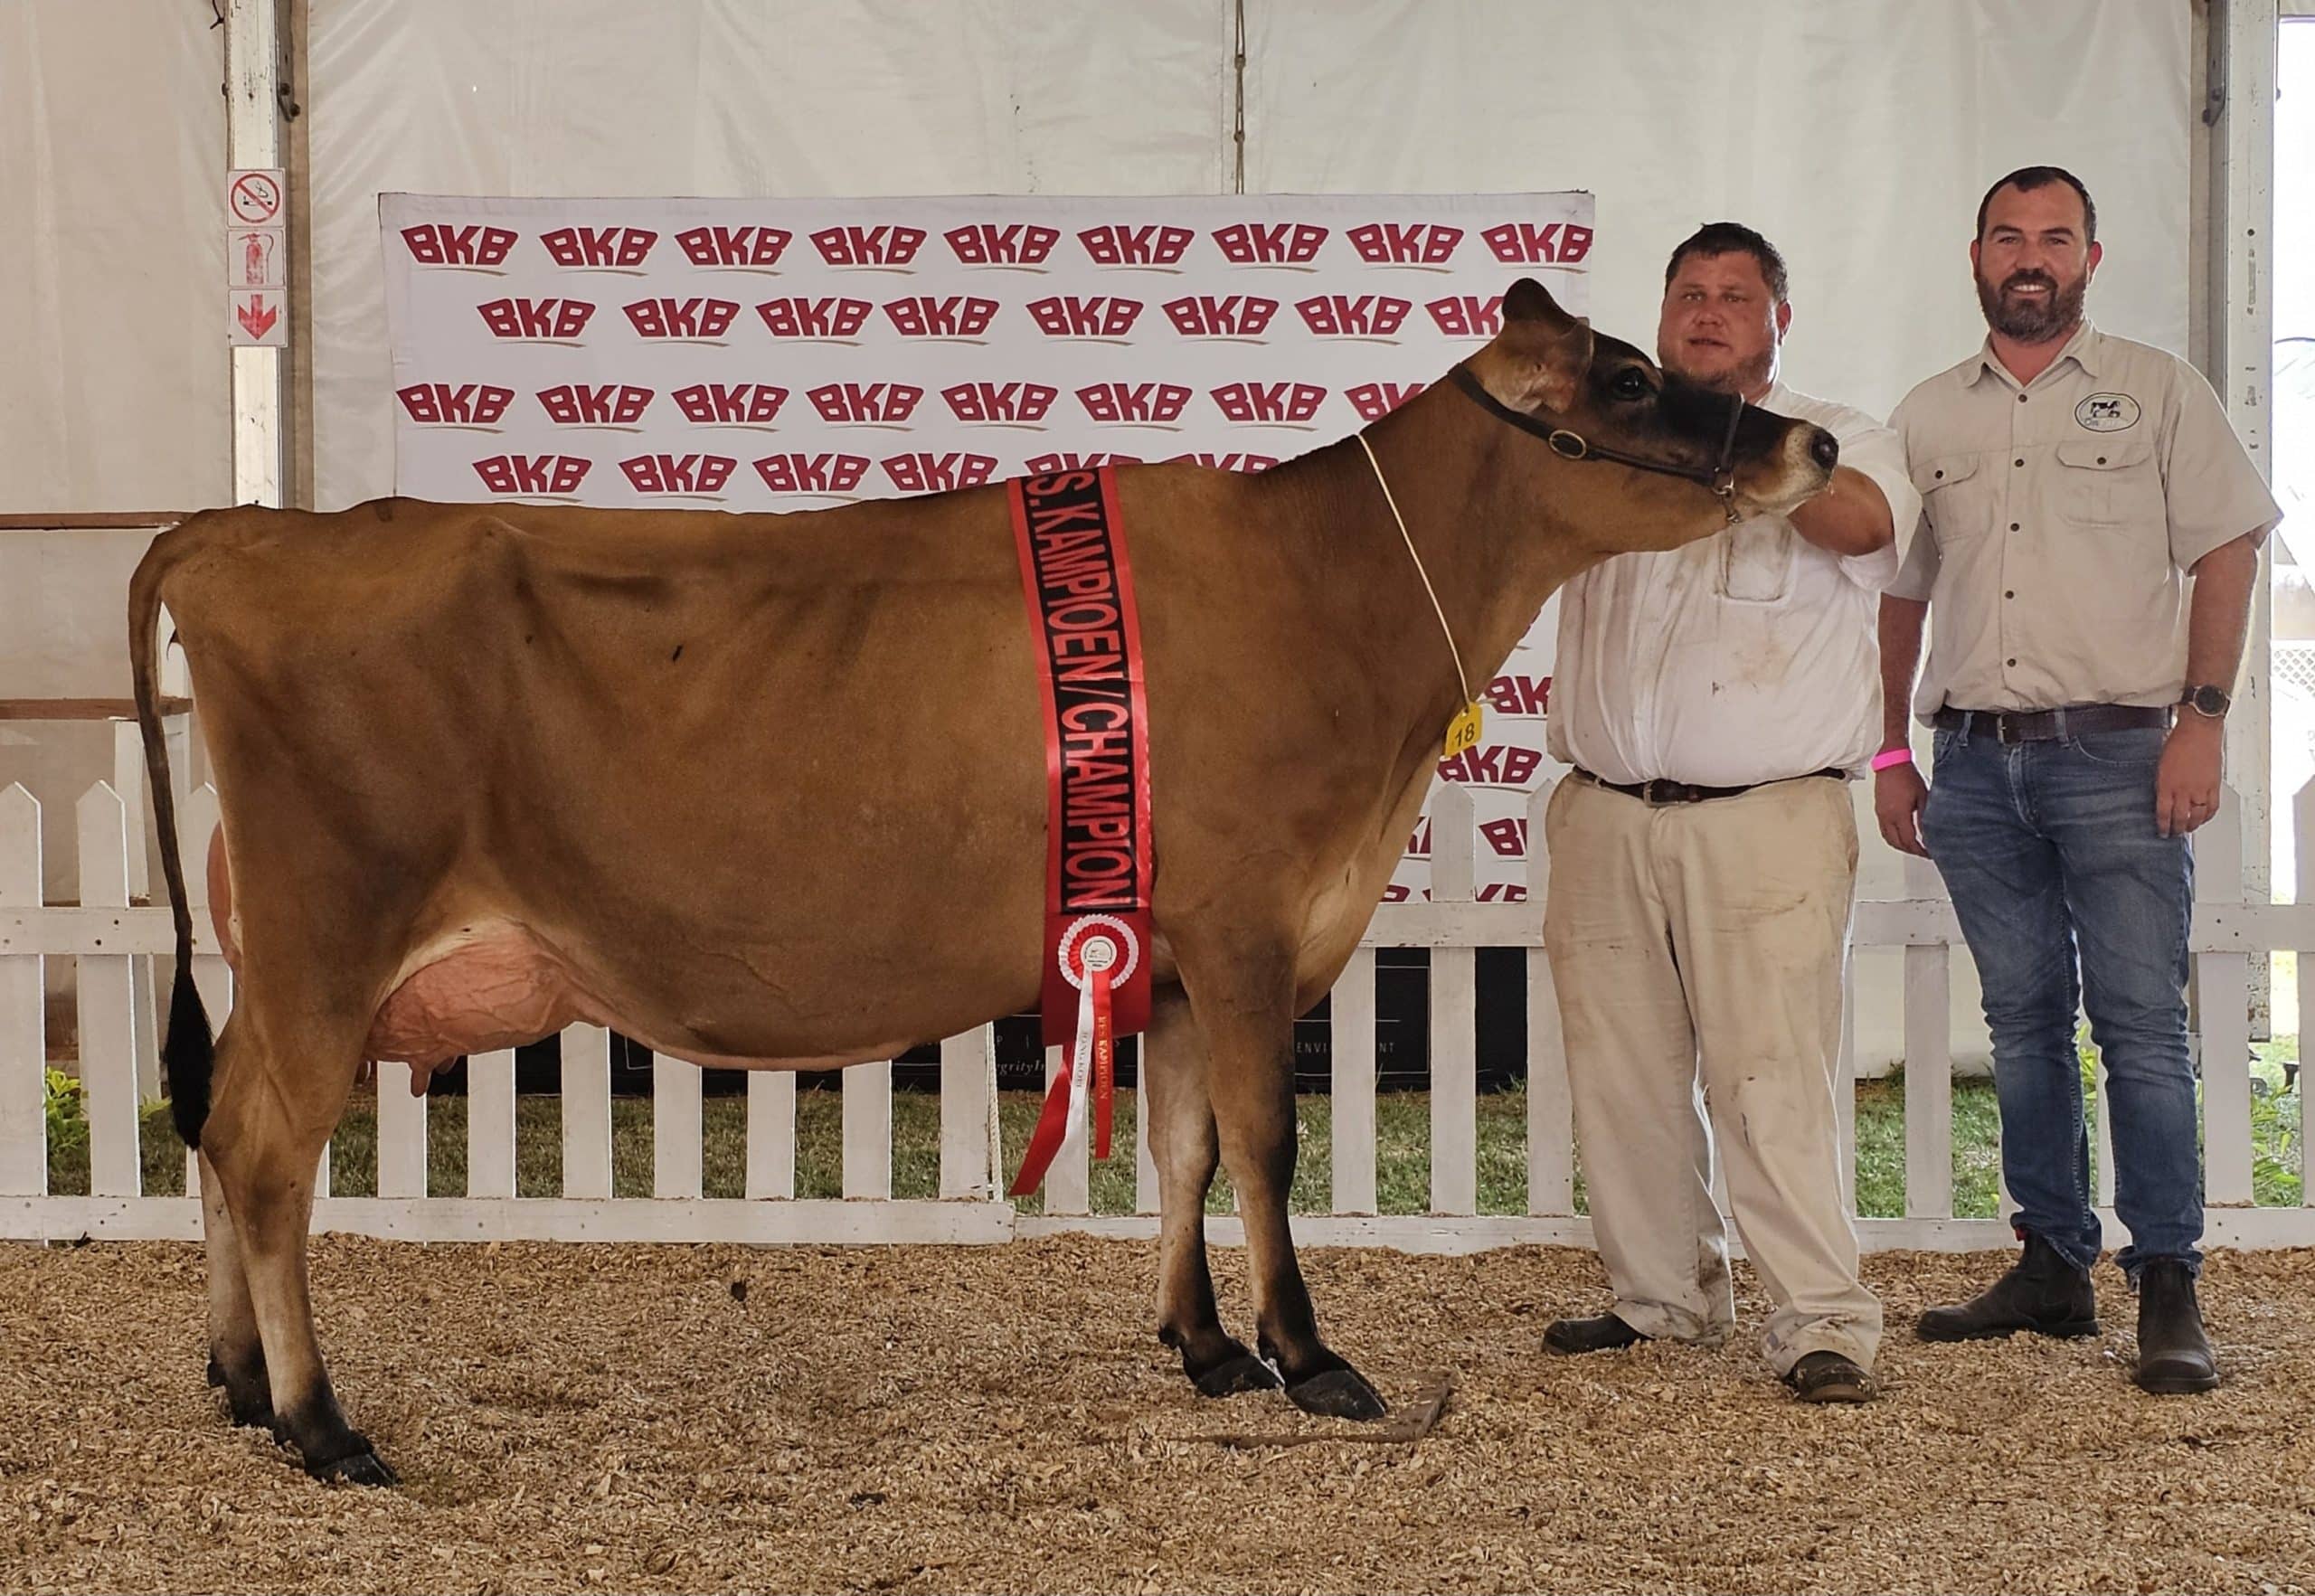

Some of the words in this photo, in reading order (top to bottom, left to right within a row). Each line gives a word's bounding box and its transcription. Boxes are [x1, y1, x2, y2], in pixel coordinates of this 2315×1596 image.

[402, 224, 518, 265] BKB
[541, 227, 657, 266] BKB
[676, 227, 792, 265] BKB
[810, 226, 927, 265] BKB
[945, 224, 1060, 264] BKB
[1079, 225, 1194, 264] BKB
[1214, 224, 1328, 262] BKB
[1346, 223, 1463, 263] BKB
[1482, 223, 1593, 263] BKB
[478, 297, 595, 338] BKB
[624, 297, 741, 337] BKB
[756, 297, 873, 337] BKB
[883, 296, 999, 336] BKB
[1026, 296, 1144, 335] BKB
[1164, 296, 1279, 335] BKB
[1296, 296, 1412, 335] BKB
[1426, 296, 1504, 337] BK
[398, 383, 514, 424] BKB
[537, 384, 654, 423] BKB
[672, 383, 789, 423] BKB
[808, 382, 924, 422] BKB
[942, 382, 1057, 421] BKB
[1077, 382, 1192, 421] BKB
[1211, 382, 1327, 421] BKB
[1345, 382, 1425, 421] BK
[473, 455, 591, 493] BKB
[620, 454, 737, 493] BKB
[753, 453, 870, 492] BKB
[882, 453, 998, 492] BKB
[1485, 675, 1553, 714] BK
[1455, 722, 1475, 747] 18
